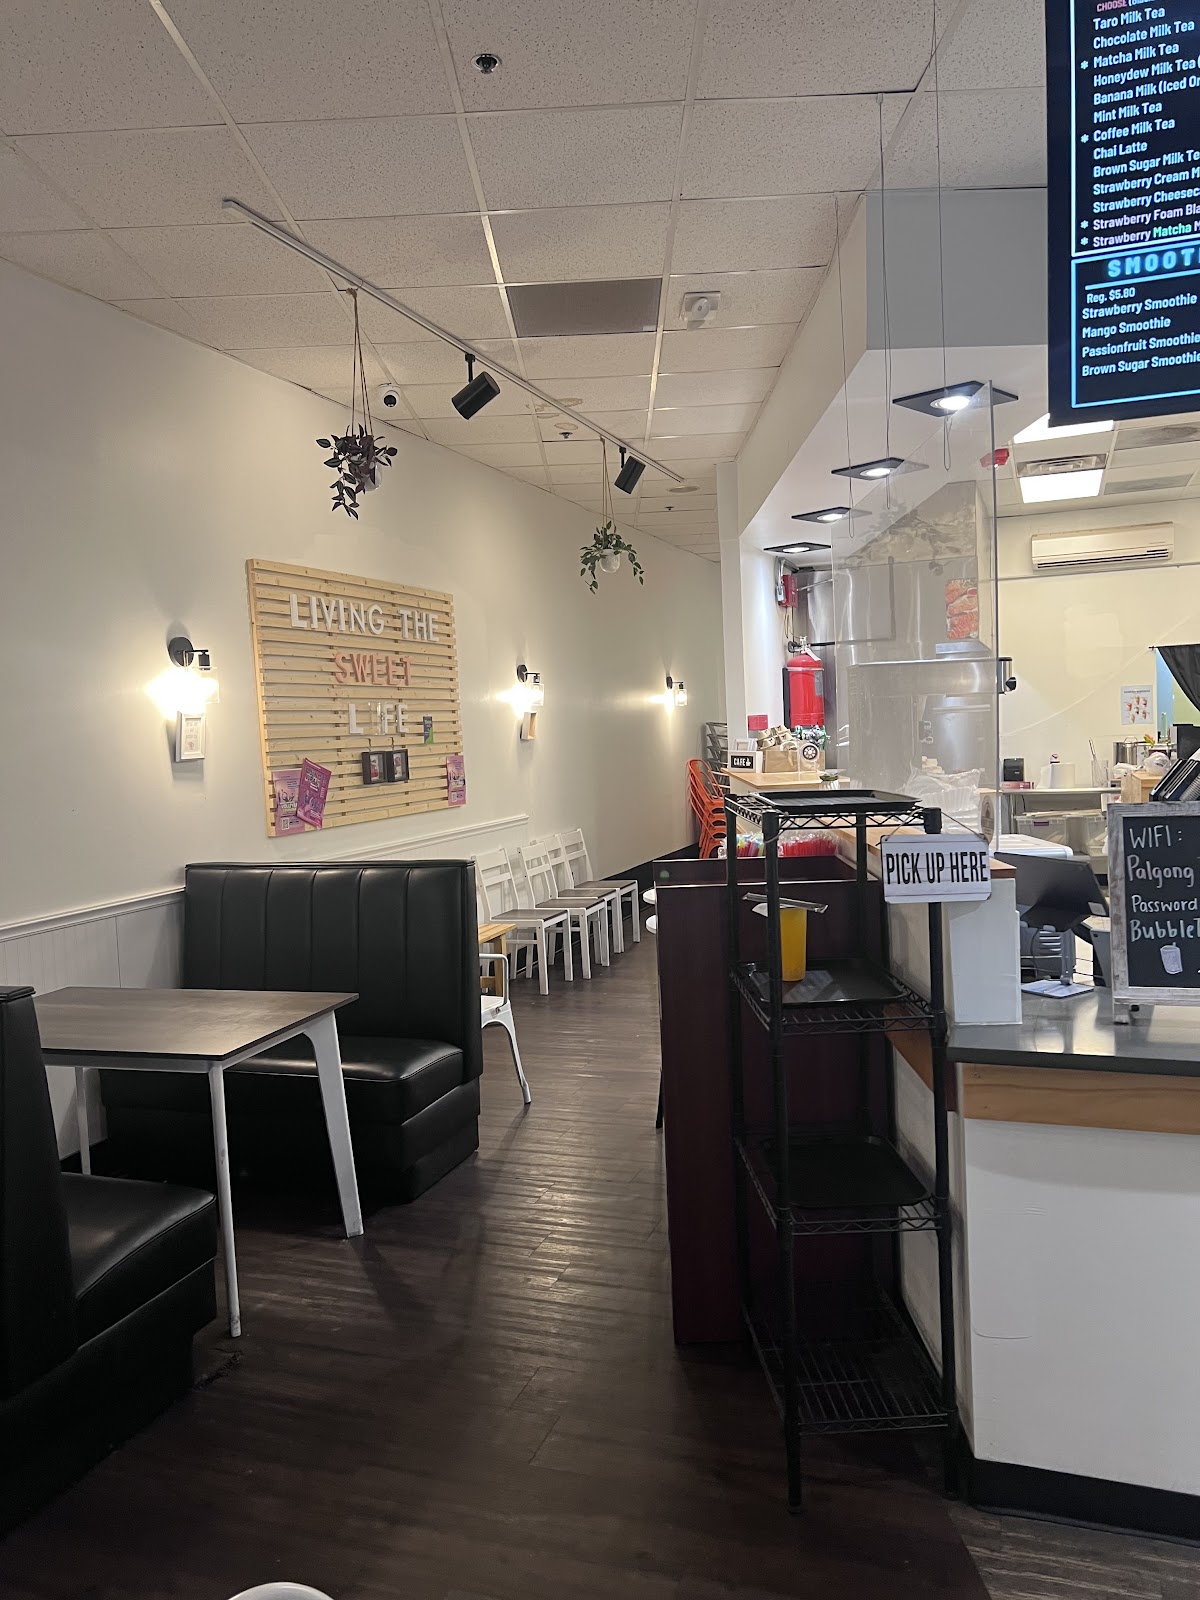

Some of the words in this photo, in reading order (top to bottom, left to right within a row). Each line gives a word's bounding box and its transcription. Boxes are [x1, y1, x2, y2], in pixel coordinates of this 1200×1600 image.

[1092, 17, 1118, 30] Taro
[1120, 10, 1142, 25] Milk
[1144, 7, 1165, 20] Tea
[1096, 0, 1127, 12] CHOOSE
[1093, 30, 1147, 49] Chocolate
[1149, 23, 1171, 38] Milk
[1174, 21, 1195, 34] Tea
[1093, 52, 1132, 68] Matcha
[1134, 45, 1156, 60] Milk
[1158, 43, 1179, 56] Tea
[1093, 67, 1149, 87] Honeydew
[1151, 61, 1173, 76] Milk
[1175, 59, 1196, 71] Tea
[1093, 89, 1133, 105] Banana
[1135, 83, 1157, 98] Milk
[1158, 77, 1186, 94] (Iced
[1093, 109, 1116, 123] Mint
[1118, 104, 1140, 119] Milk
[1141, 102, 1162, 115] Tea
[1093, 127, 1129, 142] Coffee
[1131, 121, 1152, 135] Milk
[1154, 119, 1175, 131] Tea
[1093, 144, 1117, 160] Chai
[1119, 141, 1148, 156] Latte
[1093, 163, 1127, 178] Brown
[1129, 157, 1161, 172] Sugar
[1162, 151, 1184, 166] Milk
[1093, 176, 1153, 196] Strawberry
[1154, 170, 1189, 185] Cream
[1093, 195, 1152, 213] Strawberry
[1093, 212, 1152, 230] Strawberry
[1153, 207, 1183, 221] Foam
[1093, 230, 1151, 247] Strawberry
[1153, 222, 1192, 238] Matcha
[1108, 248, 1200, 278] SMOOT
[1082, 302, 1143, 319] Strawberry
[1144, 293, 1198, 311] Smoothie
[1087, 293, 1107, 304] Reg.
[1108, 287, 1136, 301] $5.80
[1082, 325, 1117, 338] Mango
[1119, 316, 1171, 334] Smoothie
[1082, 339, 1147, 358] Passionfruit
[1149, 332, 1200, 349] Smoothie
[1082, 363, 1116, 377] Brown
[1118, 359, 1150, 373] Sugar
[289, 593, 385, 635] LIVING
[399, 609, 439, 642] THE
[334, 653, 413, 686] SWEET
[886, 852, 922, 885] PICK
[926, 852, 945, 884] UP
[949, 851, 988, 883] HERE
[1126, 854, 1194, 889] Palgong
[1131, 894, 1198, 913] Password
